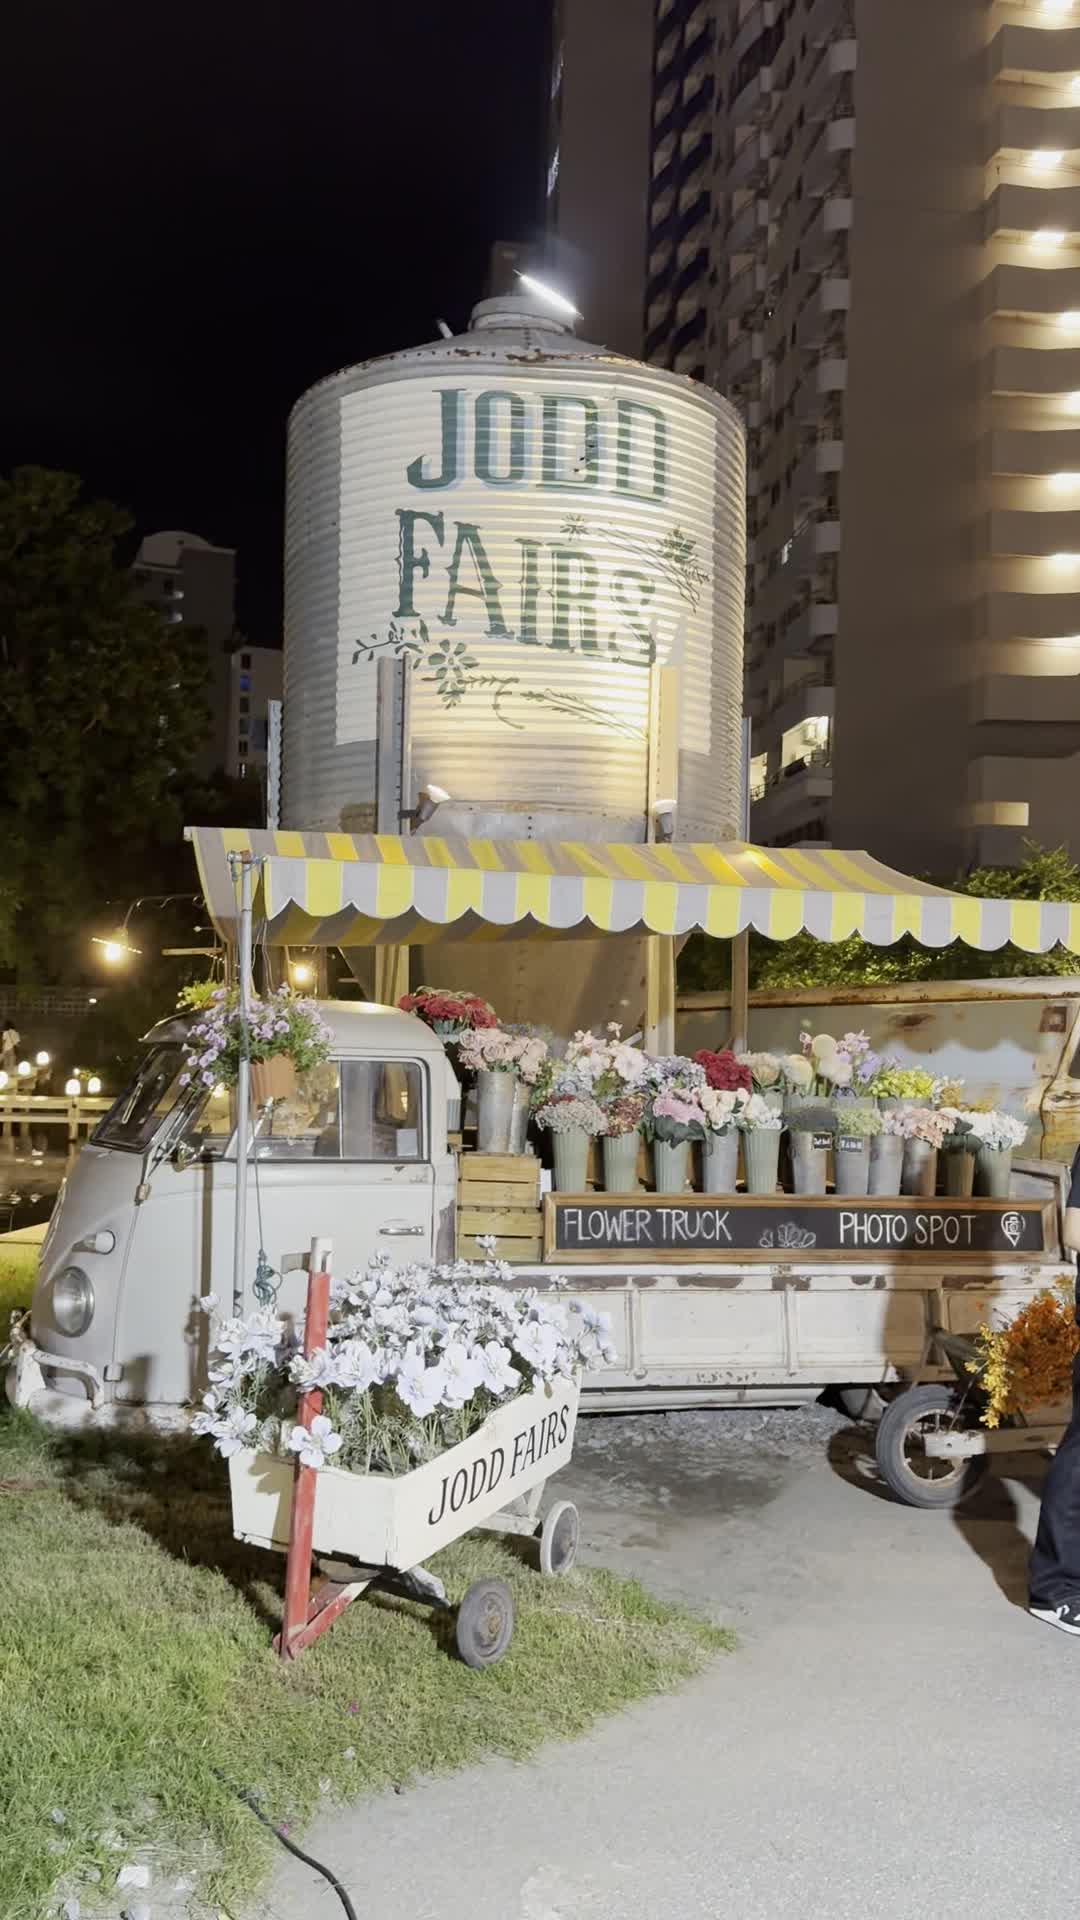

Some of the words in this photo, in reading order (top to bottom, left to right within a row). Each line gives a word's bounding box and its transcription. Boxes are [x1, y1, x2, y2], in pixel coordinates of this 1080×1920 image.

[407, 389, 666, 503] JODD
[392, 509, 656, 667] FAIRS
[564, 1208, 653, 1241] FLOWER
[656, 1208, 732, 1240] TRUCK
[839, 1211, 908, 1244] PHOTO
[914, 1215, 976, 1245] SPOT
[428, 1447, 504, 1525] JODD
[510, 1404, 570, 1478] FAIRS
